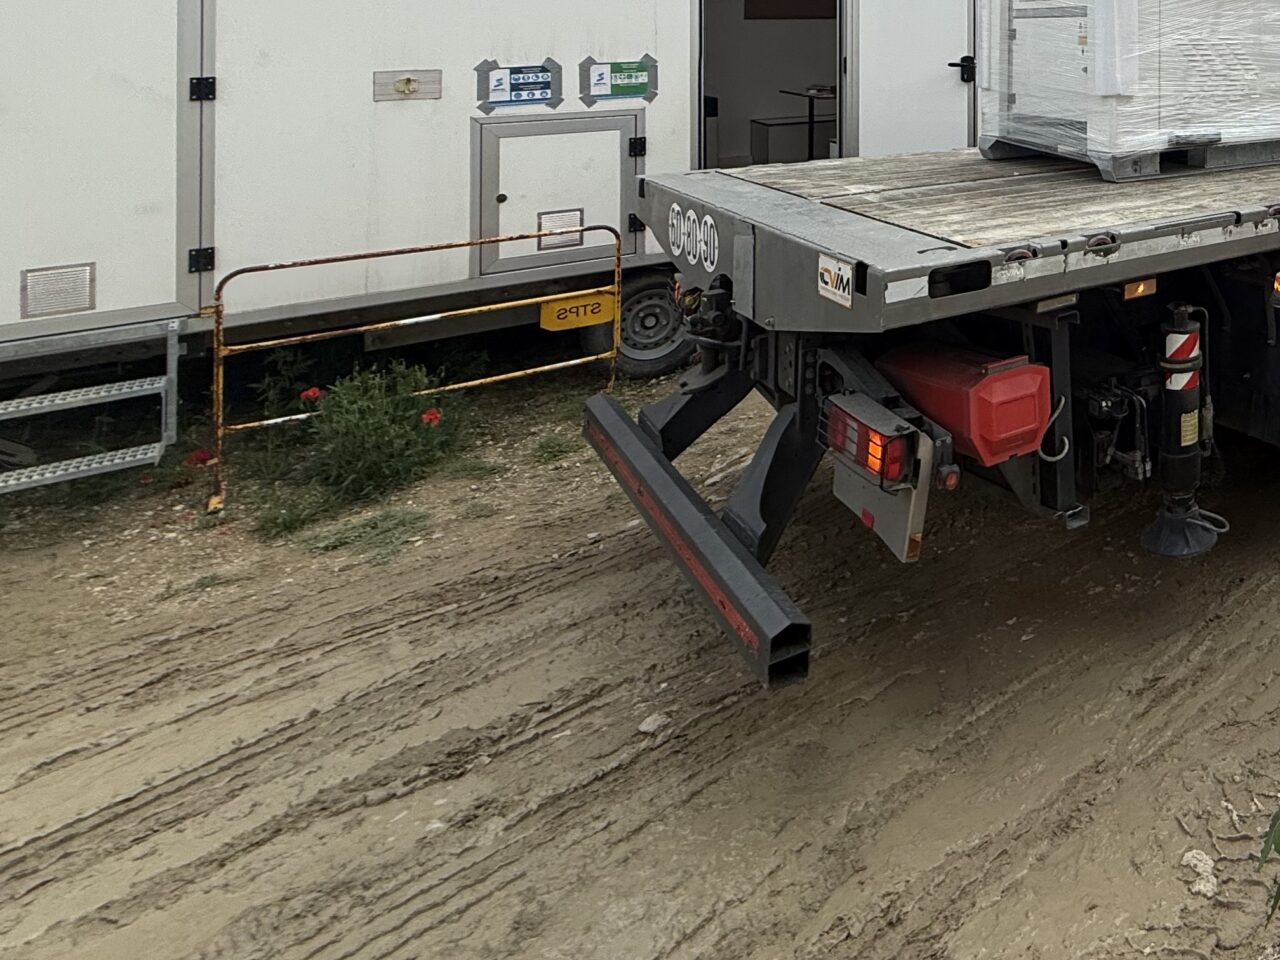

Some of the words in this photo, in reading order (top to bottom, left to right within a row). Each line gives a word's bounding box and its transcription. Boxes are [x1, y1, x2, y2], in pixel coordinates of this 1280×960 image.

[671, 208, 683, 251] 60
[687, 215, 698, 260] 80
[703, 220, 716, 267] 90
